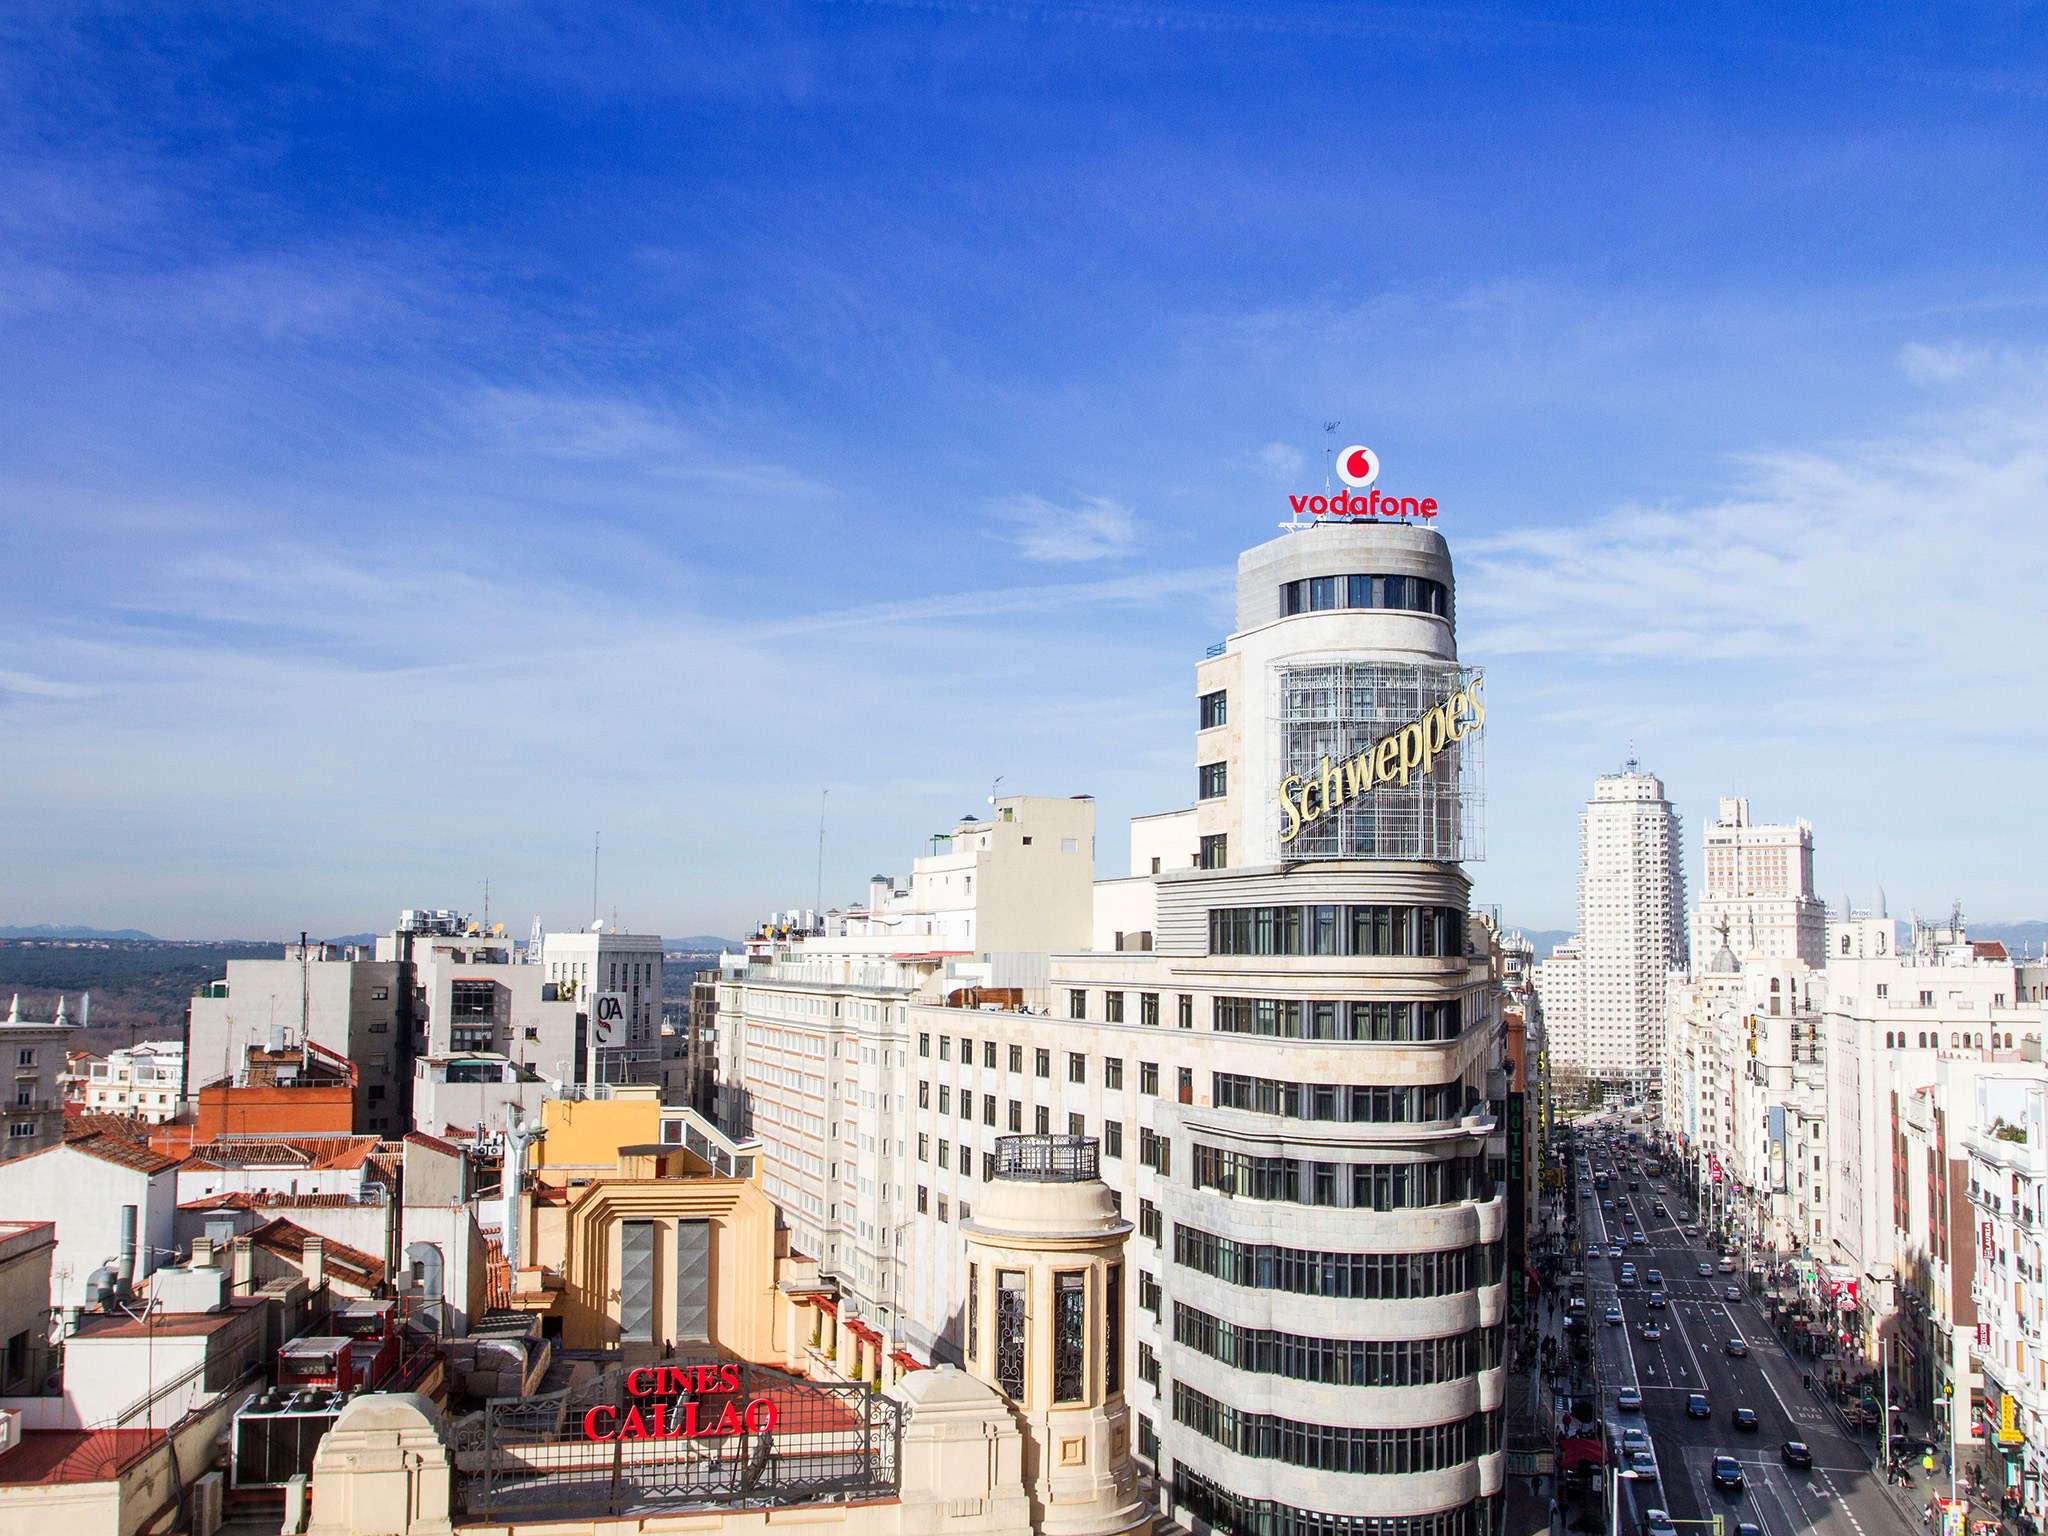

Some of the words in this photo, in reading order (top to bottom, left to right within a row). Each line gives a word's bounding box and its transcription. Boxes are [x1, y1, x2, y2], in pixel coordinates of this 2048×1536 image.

[1289, 490, 1438, 517] vodafone
[1279, 676, 1485, 843] Schweppes
[1510, 1097, 1521, 1180] HOTEL
[1984, 1222, 1992, 1250] LAURIA
[1510, 1269, 1522, 1319] REX
[627, 1364, 739, 1397] CINES
[583, 1398, 778, 1441] CALLAO
[1794, 1405, 1823, 1413] TAXI
[1799, 1412, 1823, 1420] BUS
